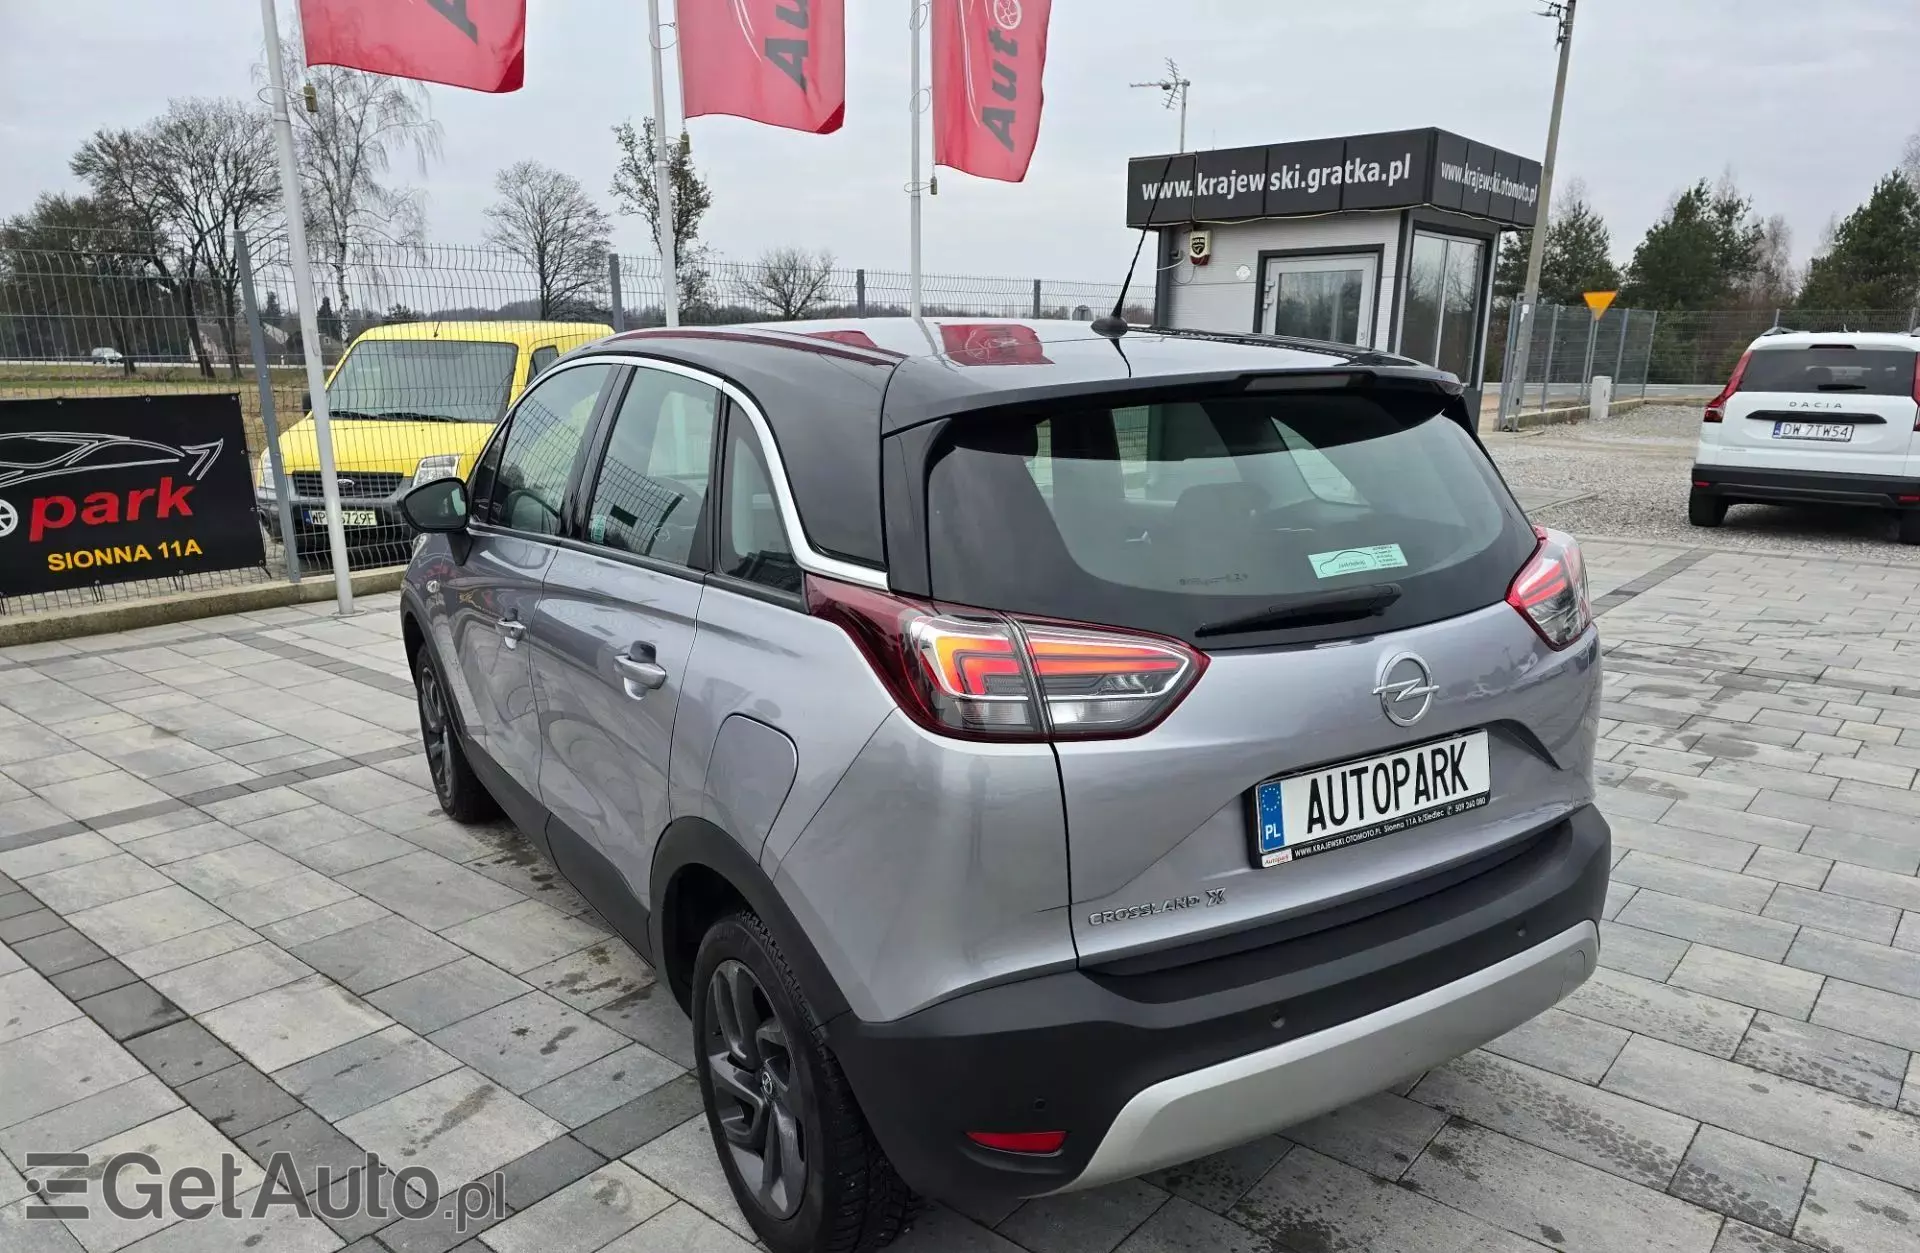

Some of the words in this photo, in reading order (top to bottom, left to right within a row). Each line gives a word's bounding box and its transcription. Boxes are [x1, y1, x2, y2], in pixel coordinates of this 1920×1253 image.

[1789, 401, 1843, 409] DACIA
[1783, 424, 1800, 436] DW
[1807, 425, 1849, 438] 7TW54
[47, 544, 152, 572] SIONNA
[157, 539, 203, 559] 11A
[1306, 741, 1470, 834] AUTOPARK
[1265, 823, 1281, 841] PL
[1294, 827, 1382, 857] WWW.KRAJEWSKI.OTOMOTO.PL
[1384, 822, 1405, 833] Sionna
[1406, 816, 1417, 827] 11A
[1088, 896, 1200, 926] CROSSLAND
[1206, 887, 1227, 907] X
